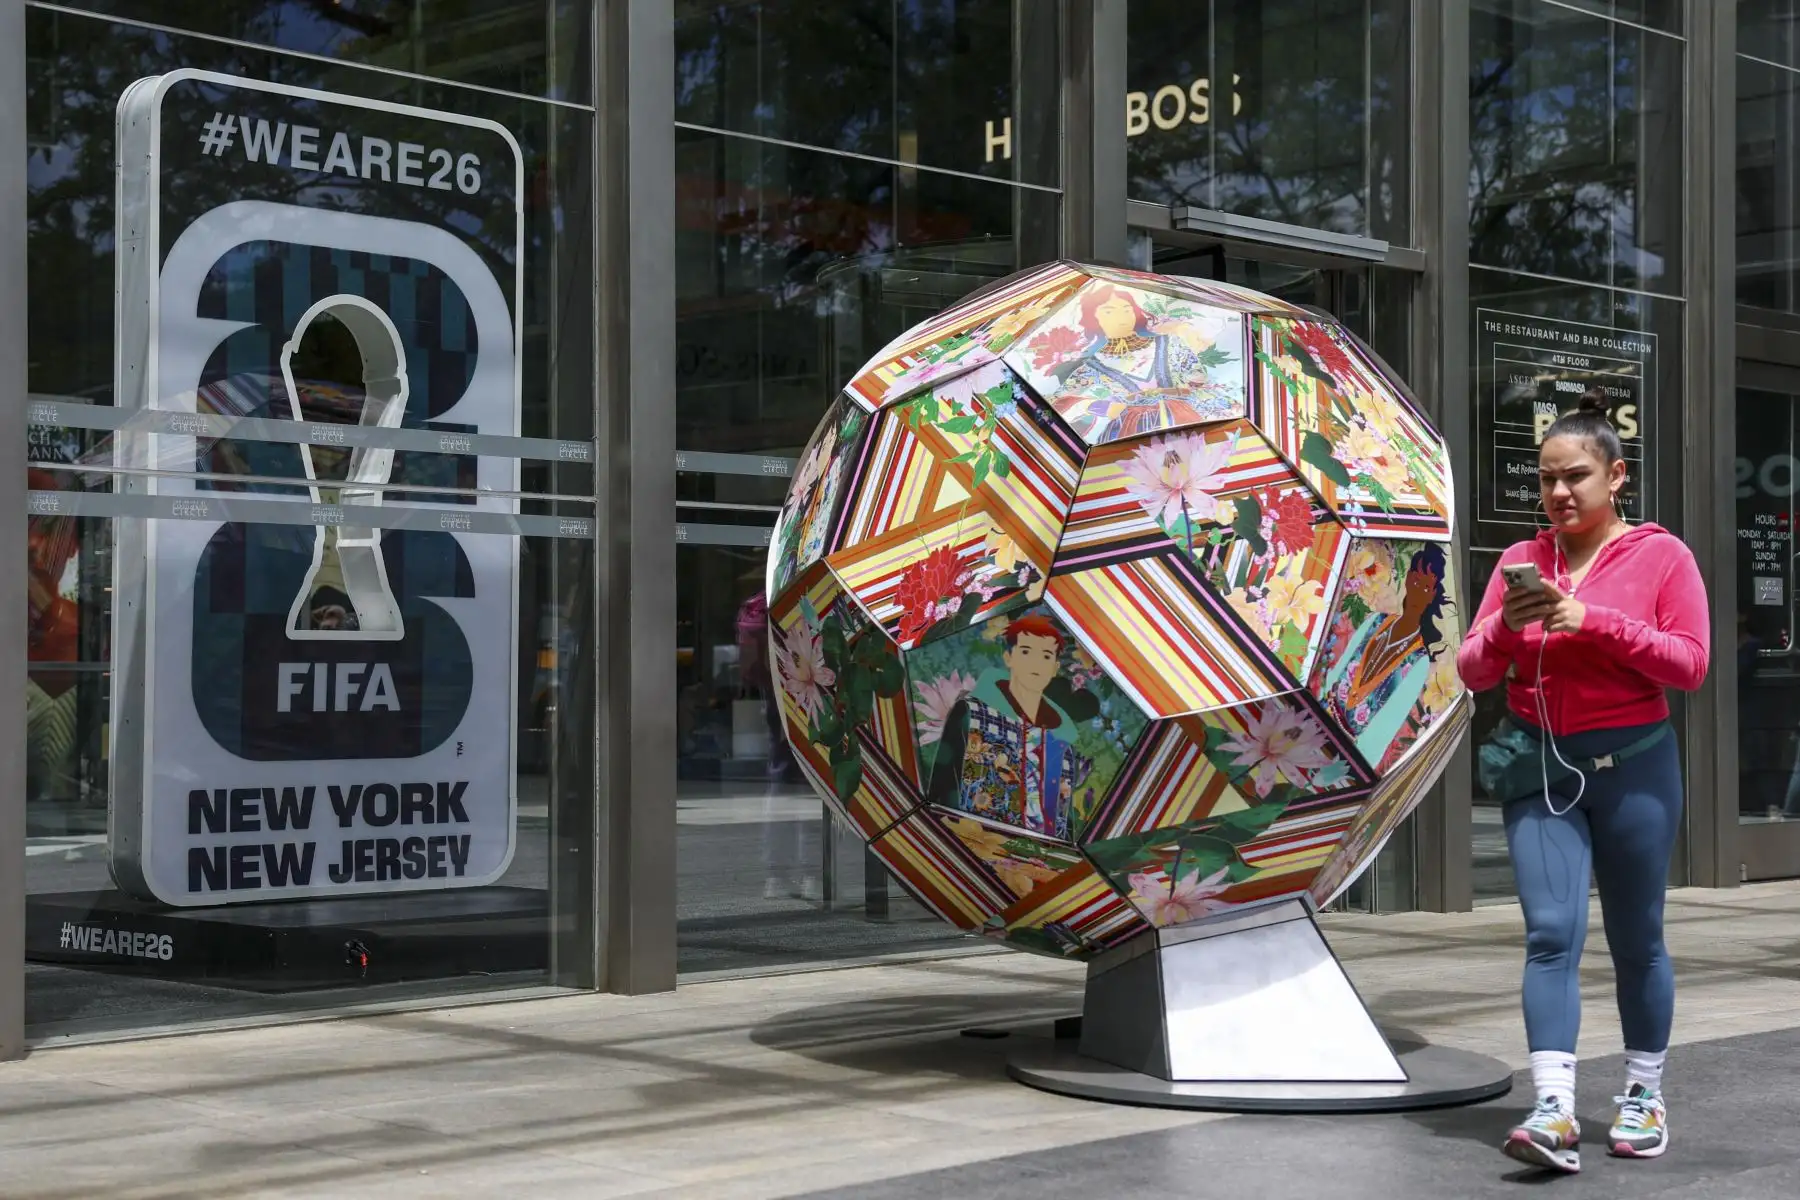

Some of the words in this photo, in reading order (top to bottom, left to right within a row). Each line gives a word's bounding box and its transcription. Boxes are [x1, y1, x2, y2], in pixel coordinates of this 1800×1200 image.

[199, 112, 482, 195] #WEARE26
[1485, 321, 1501, 332] THE
[1505, 324, 1560, 341] RESTAURANT
[1563, 332, 1580, 343] AND
[1583, 335, 1599, 347] BAR
[1602, 338, 1652, 353] COLLECTION
[1552, 355, 1565, 365] 4TH
[1567, 357, 1590, 367] FLOOR
[1533, 401, 1558, 416] MASA
[312, 434, 344, 443] CIRCLE
[1755, 514, 1777, 525] HOURS
[1737, 529, 1762, 539] MONDAY
[1755, 552, 1777, 561] SUNDAY
[1752, 562, 1766, 571] 11AM
[276, 662, 401, 713] FIFA
[188, 786, 316, 834] NEW
[327, 781, 470, 828] YORK
[188, 842, 316, 892] NEW
[328, 834, 471, 884] JERSEY
[60, 921, 174, 961] #WEARE26
